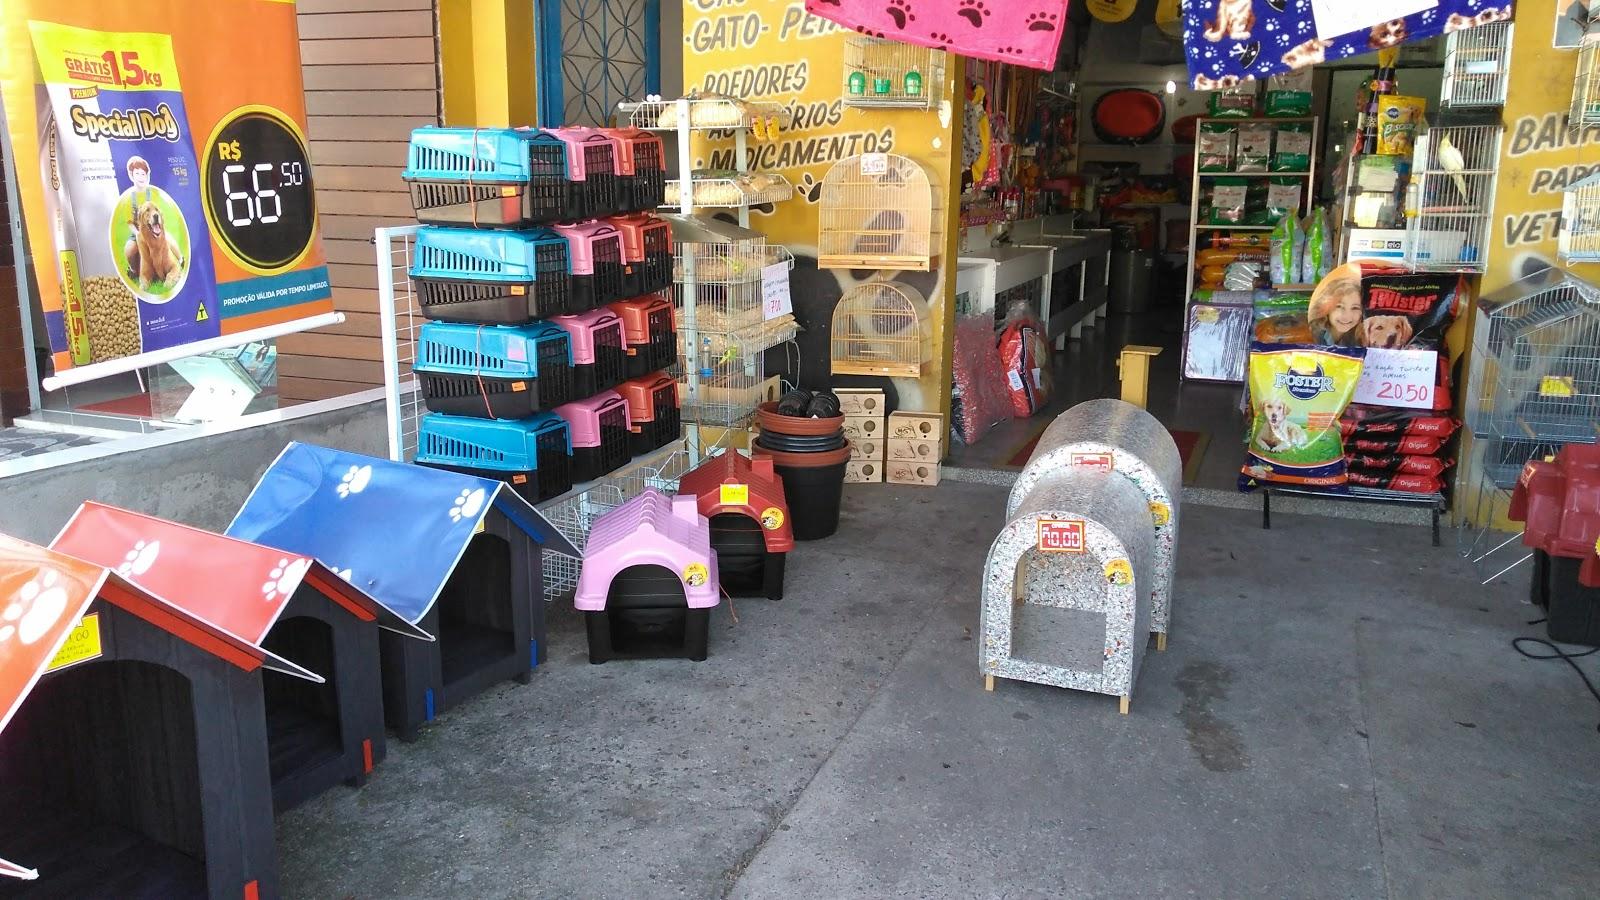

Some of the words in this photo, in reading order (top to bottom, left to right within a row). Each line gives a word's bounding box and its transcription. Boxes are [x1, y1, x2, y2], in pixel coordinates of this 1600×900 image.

[64, 57, 111, 76] GRÁTIS
[703, 62, 807, 98] ROEDORES
[70, 104, 142, 143] Special
[138, 102, 180, 142] Dog
[217, 139, 242, 162] R$
[709, 130, 893, 171] MDICAMENTOS
[223, 293, 256, 307] PROMOÇÃO
[256, 290, 275, 300] VÁLIDA
[275, 289, 288, 297] POR
[288, 285, 306, 294] TEMPO
[1274, 373, 1336, 392] FOSTER
[1418, 424, 1439, 432] Original
[1408, 442, 1428, 450] Original
